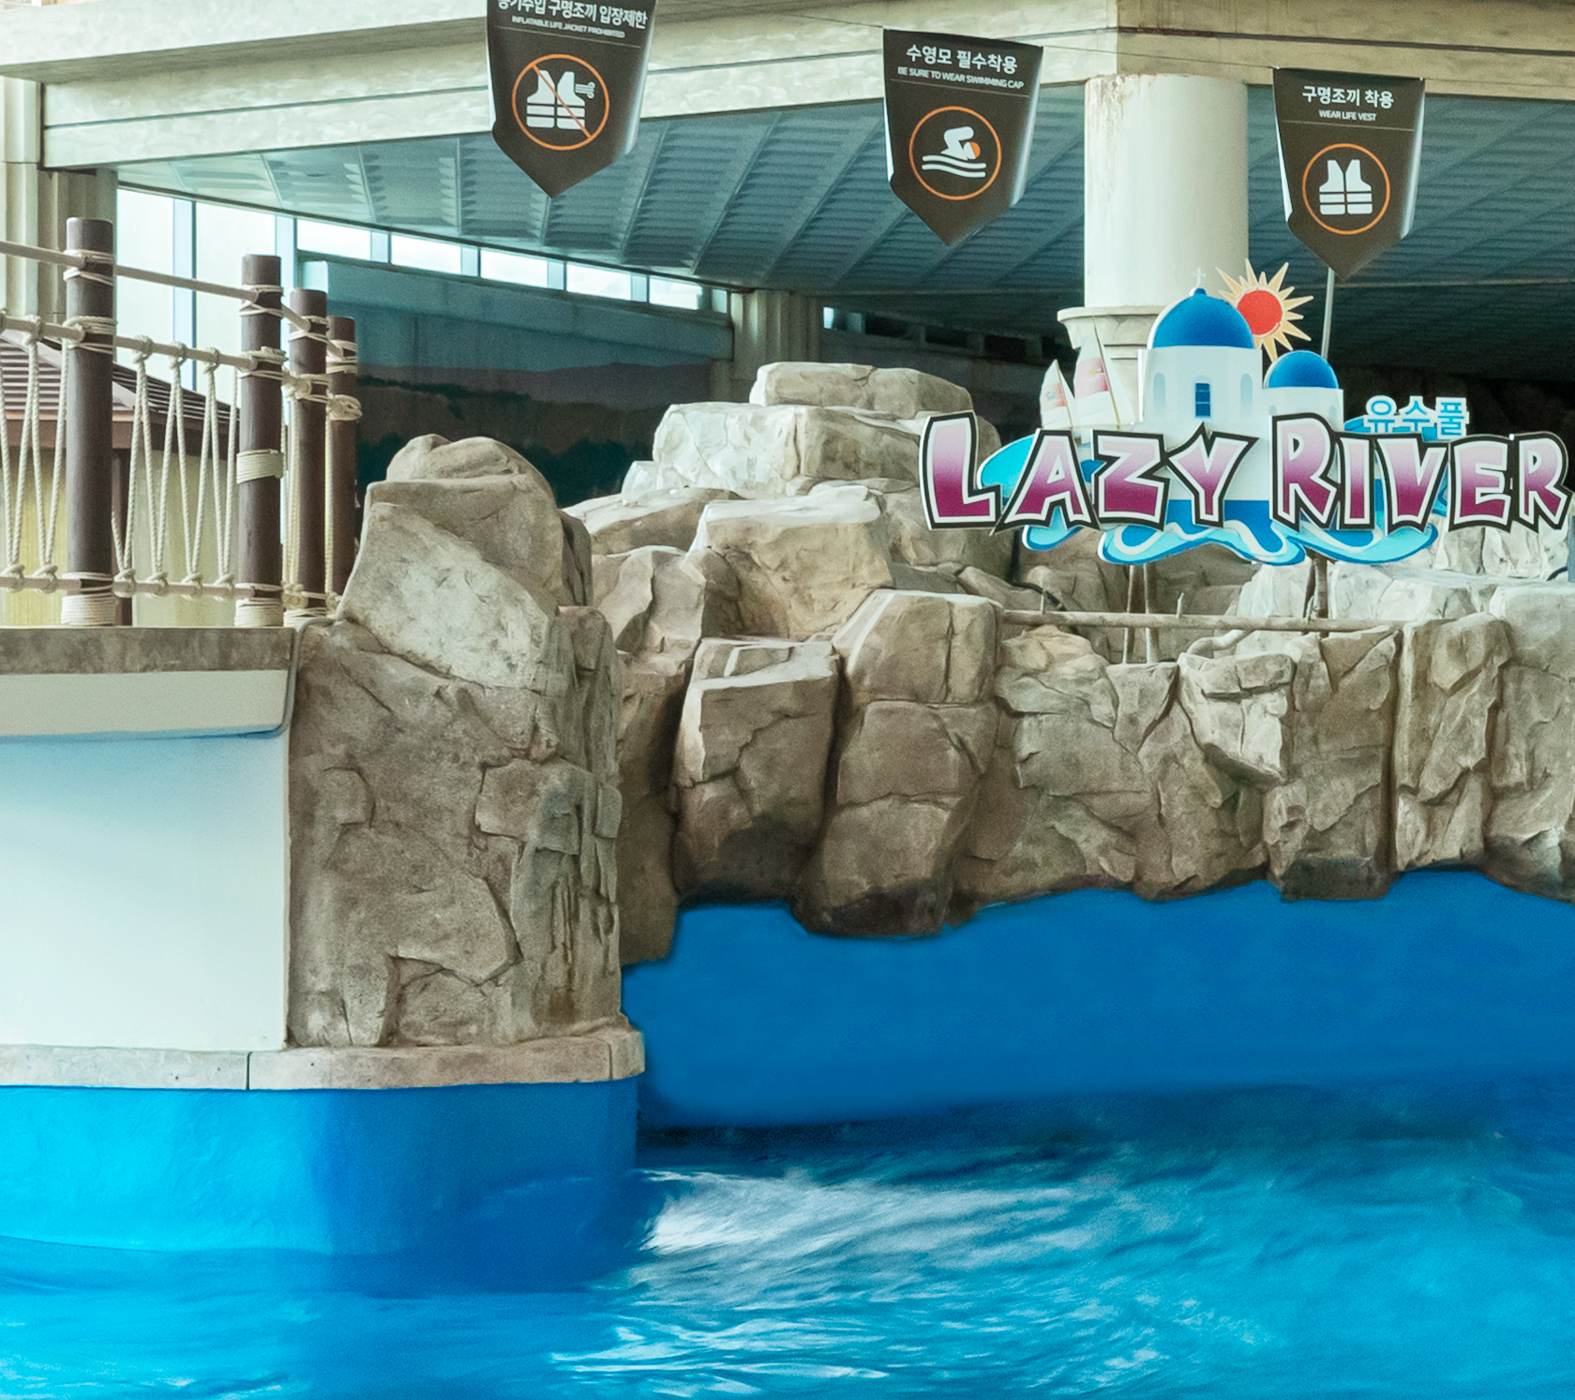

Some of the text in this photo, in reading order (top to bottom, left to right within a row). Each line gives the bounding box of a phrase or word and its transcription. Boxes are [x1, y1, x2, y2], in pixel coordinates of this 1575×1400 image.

[550, 21, 563, 30] LIFE
[563, 22, 587, 33] JACKET
[599, 6, 648, 29] 입장제한
[906, 44, 1017, 74] 수영모 필수착용
[898, 66, 1024, 89] BE SURE TO WEAR SWIMMING CAP
[1302, 86, 1394, 109] 구명조끼 착용
[1319, 109, 1377, 121] WEAR LIFE VEST
[1365, 396, 1468, 438] 유수풀
[919, 411, 1573, 536] LAZY RIVER
